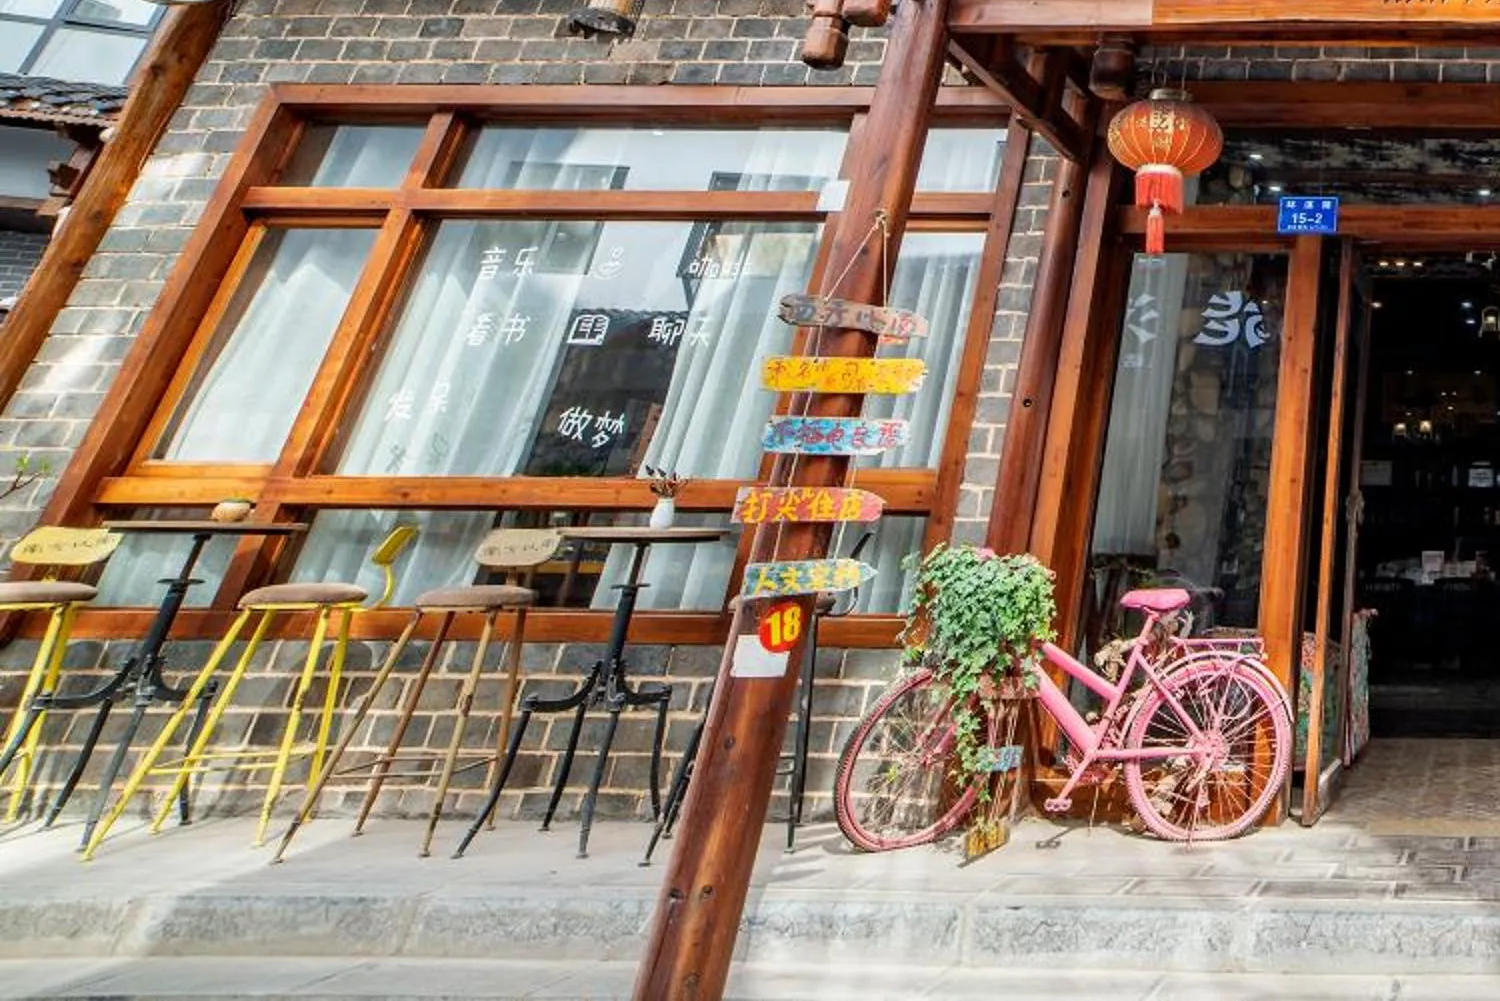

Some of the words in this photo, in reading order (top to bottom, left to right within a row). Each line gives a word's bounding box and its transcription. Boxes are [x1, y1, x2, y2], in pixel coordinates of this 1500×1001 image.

[1292, 212, 1324, 224] 15-2
[480, 246, 538, 280] 音乐
[467, 312, 531, 346] 看书
[648, 315, 711, 347] 聊天
[558, 406, 626, 449] 做梦
[766, 605, 802, 647] 18
